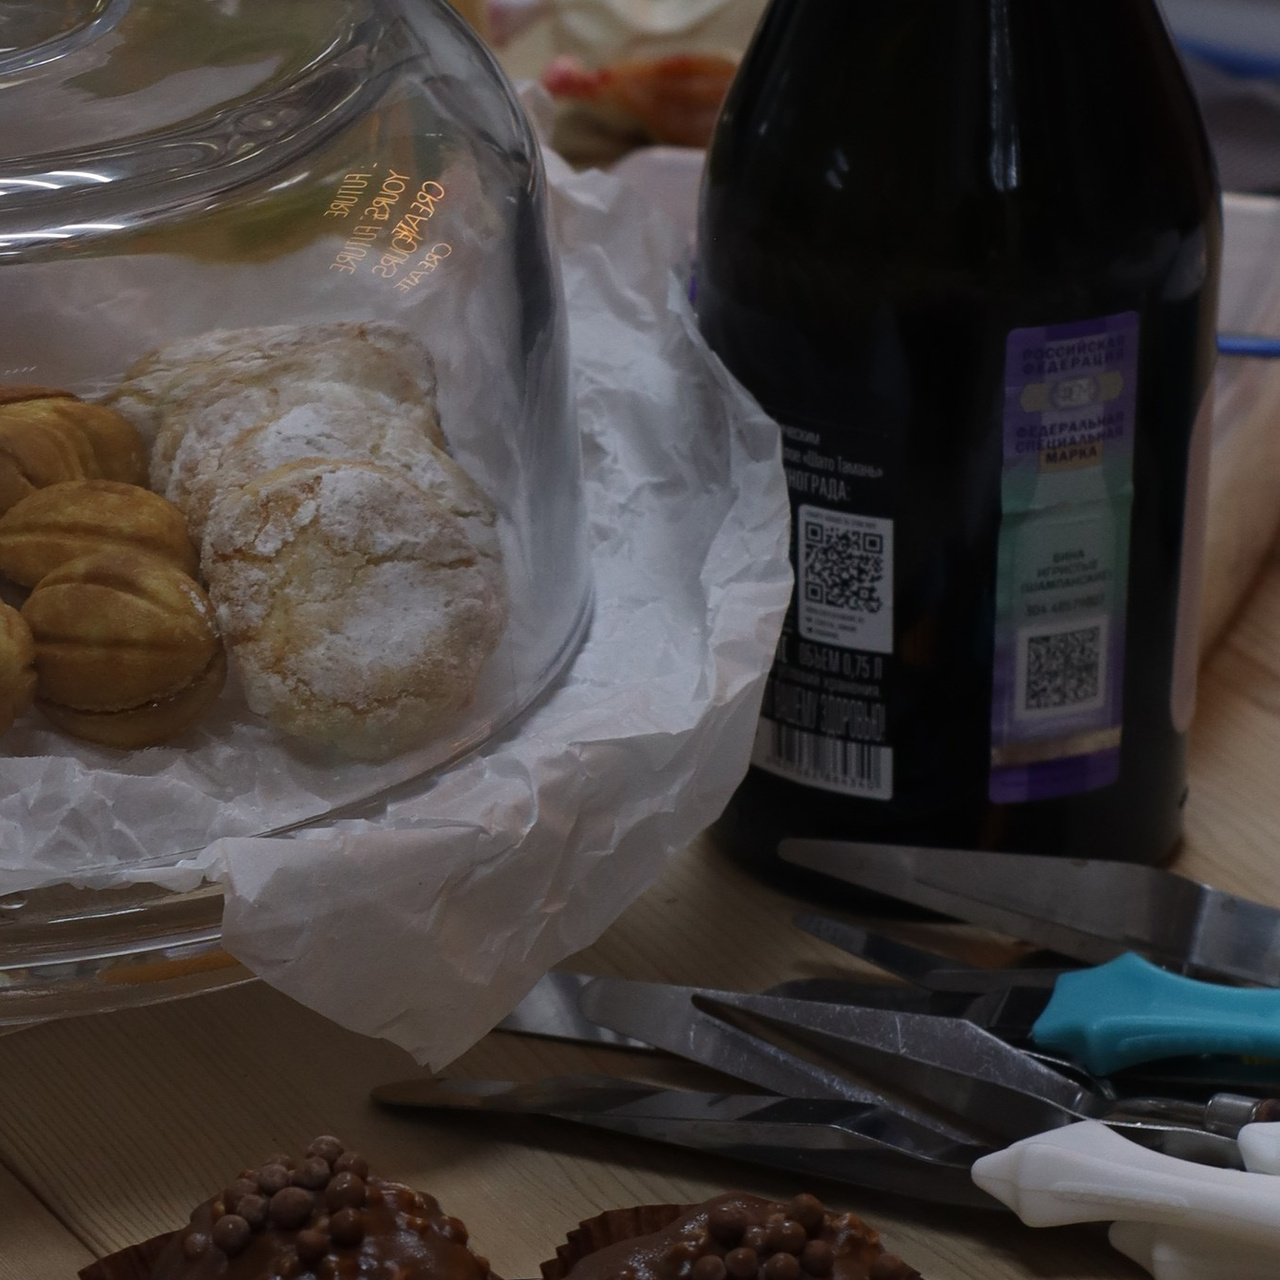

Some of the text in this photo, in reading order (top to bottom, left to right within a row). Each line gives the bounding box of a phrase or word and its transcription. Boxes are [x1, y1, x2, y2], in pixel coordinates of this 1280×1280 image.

[1022, 334, 1125, 361] РОССИЙСКАЯ
[1022, 347, 1125, 375] ФЕДЕРАЦИЯ
[1016, 411, 1125, 438] ФЕДЕРАЛЬНАЯ
[1015, 426, 1124, 454] СПЕЦИАЛЬНАЯ
[1045, 446, 1097, 463] МАРКА
[842, 652, 870, 679] 0,75
